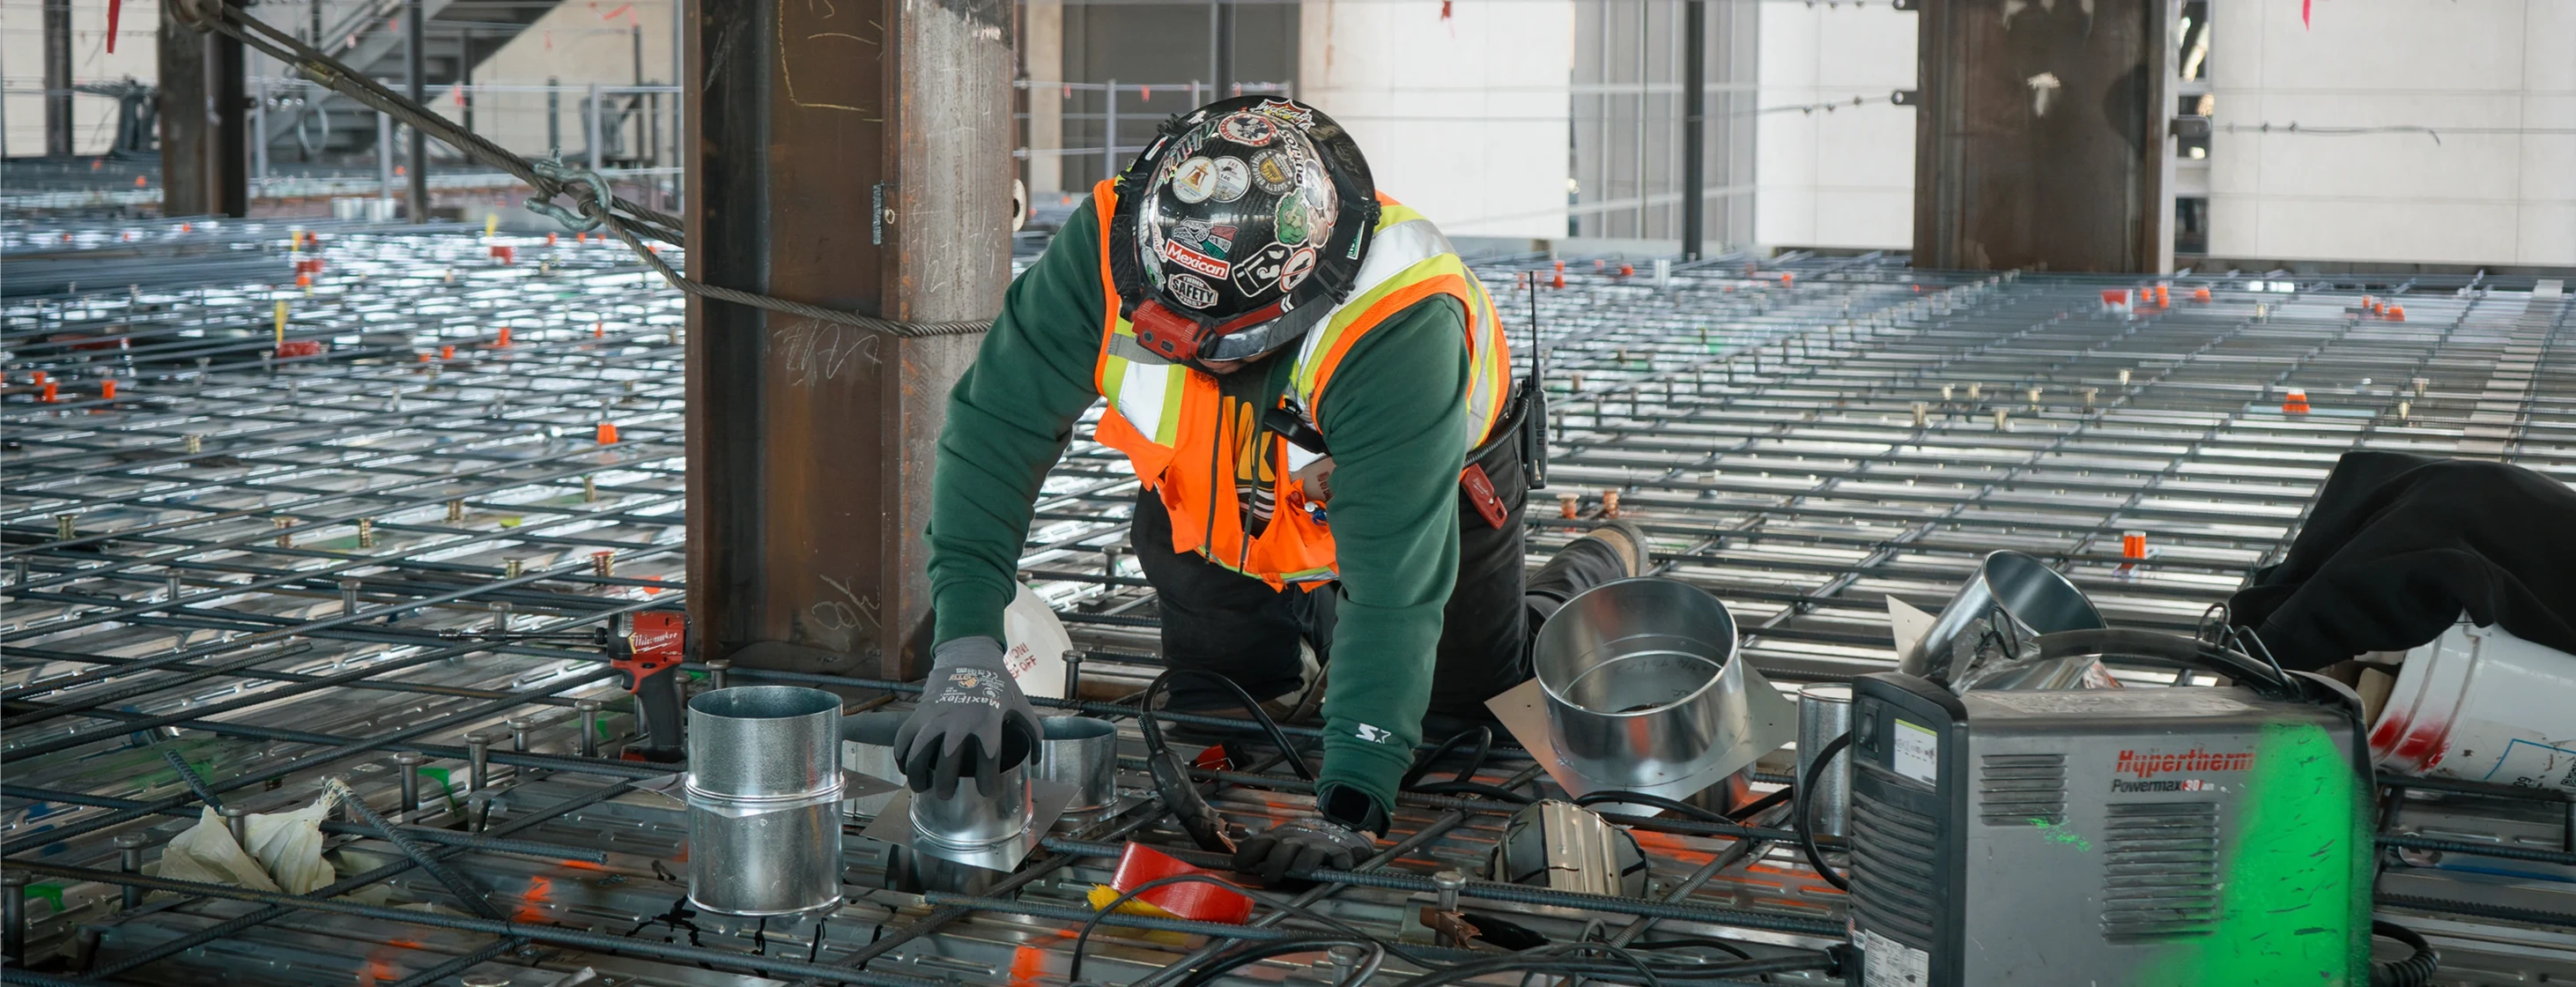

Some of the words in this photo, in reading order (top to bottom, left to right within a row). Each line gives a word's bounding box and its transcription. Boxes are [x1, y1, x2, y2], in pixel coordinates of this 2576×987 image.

[1265, 182, 1288, 191] SAFETY
[1167, 244, 1226, 277] Mexican
[1182, 276, 1204, 288] THINK
[1173, 278, 1215, 302] SAFETY
[1180, 295, 1203, 307] FIRST
[633, 632, 677, 647] Milwaukee
[1019, 655, 1036, 672] OFF
[938, 695, 1000, 709] MaxiFlex
[2116, 748, 2255, 778] Hypertherm
